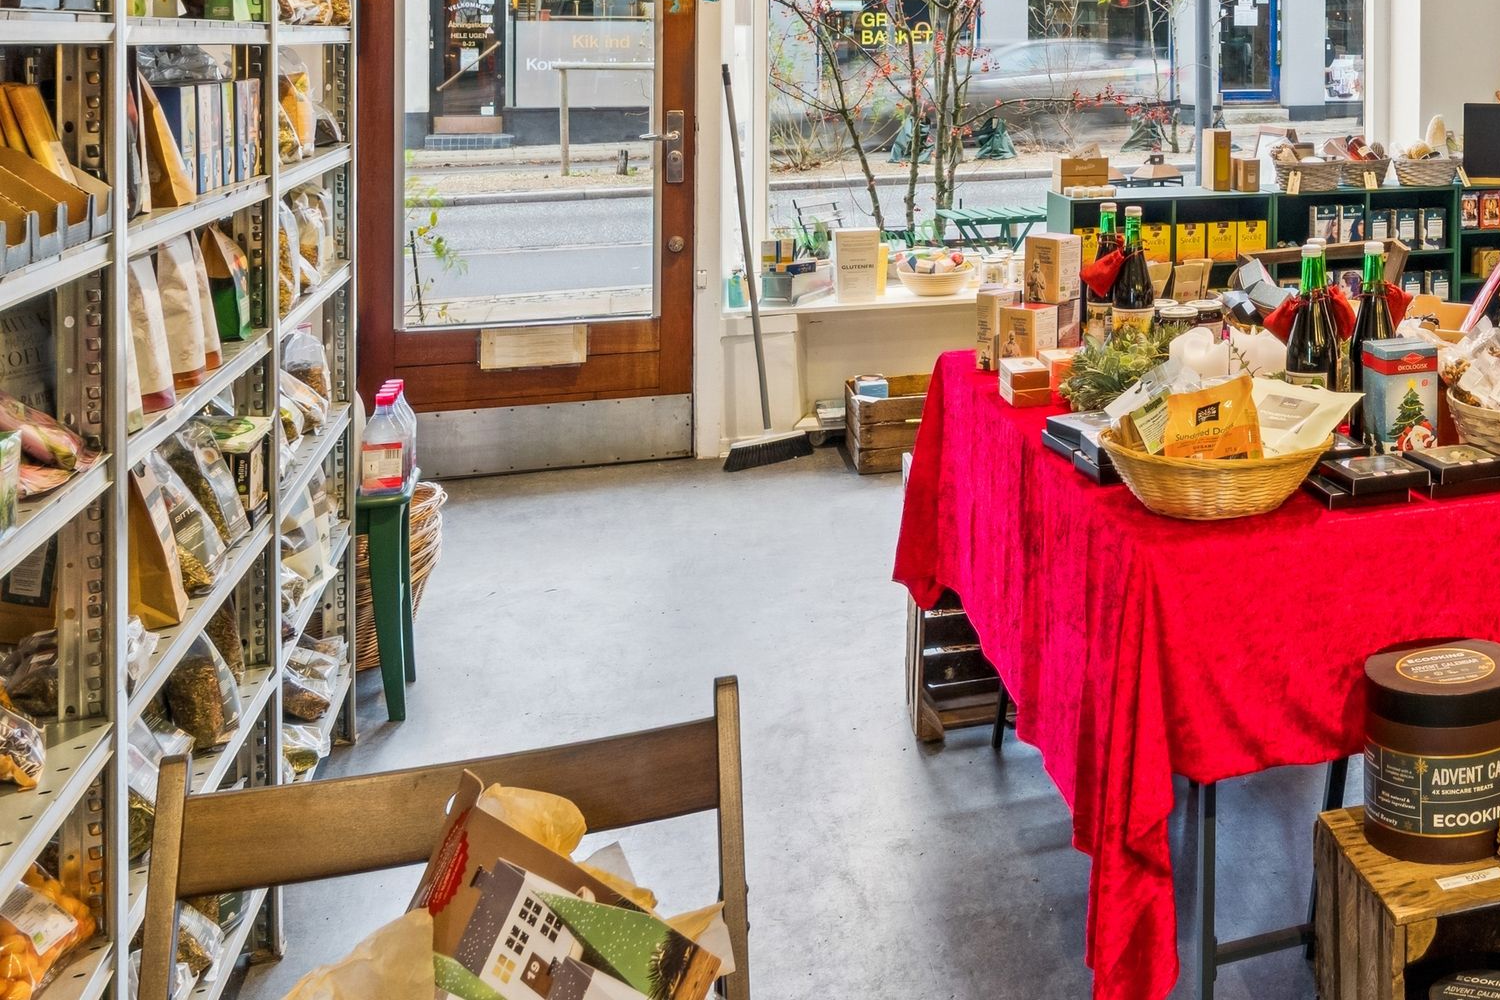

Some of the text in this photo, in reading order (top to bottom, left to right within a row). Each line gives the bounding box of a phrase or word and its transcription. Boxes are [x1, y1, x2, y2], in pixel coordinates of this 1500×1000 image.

[448, 2, 490, 13] VELKOMMEN
[572, 33, 631, 49] Kik ind
[1397, 362, 1428, 371] ØKOLOGISK
[1407, 652, 1465, 664] ECOOKING
[1411, 658, 1480, 672] ADVENT CALENDAR
[1431, 765, 1484, 786] ADVENT
[1442, 787, 1472, 796] SKINCARE
[1473, 783, 1494, 793] TREATS
[526, 960, 541, 981] 19
[1445, 985, 1476, 995] ADVENT
